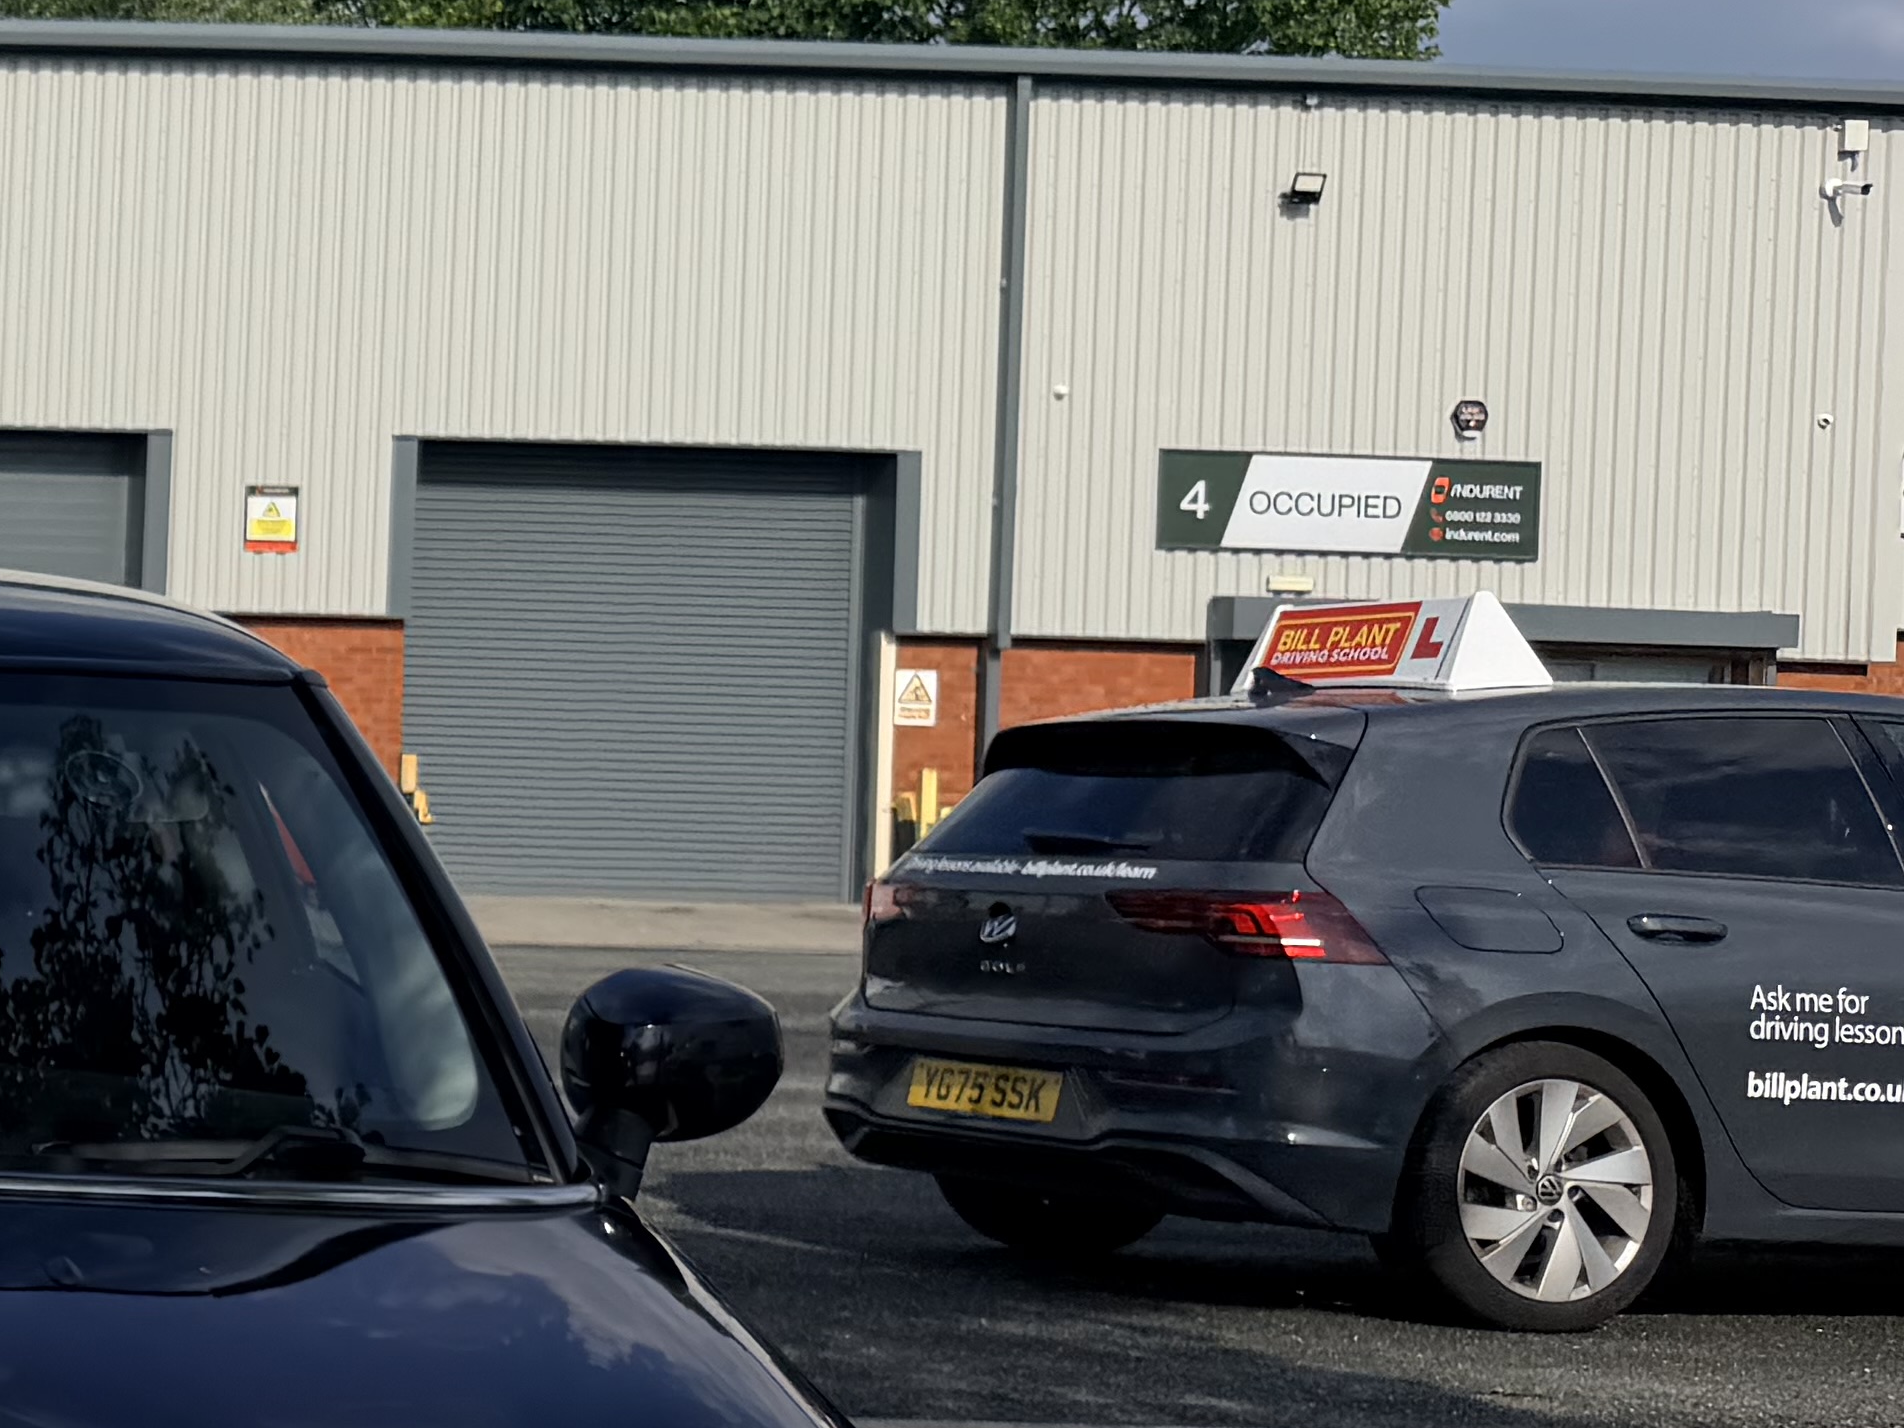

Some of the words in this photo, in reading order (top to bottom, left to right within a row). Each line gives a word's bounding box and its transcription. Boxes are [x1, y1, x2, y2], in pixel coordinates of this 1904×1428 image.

[1180, 479, 1211, 519] 4
[1249, 490, 1402, 520] OCCUPIED
[1277, 626, 1322, 652] BILL
[1327, 622, 1401, 647] PLANT
[1410, 616, 1444, 660] L
[1270, 648, 1330, 666] DRIVING
[1329, 645, 1390, 664] SCHOOL
[1750, 984, 1792, 1012] Ask
[1795, 992, 1834, 1013] me
[1836, 986, 1870, 1015] for
[1749, 1012, 1830, 1049] driving
[923, 1064, 988, 1105] YG75
[990, 1073, 1047, 1113] SSK
[1747, 1070, 1904, 1106] billplant.co.u
